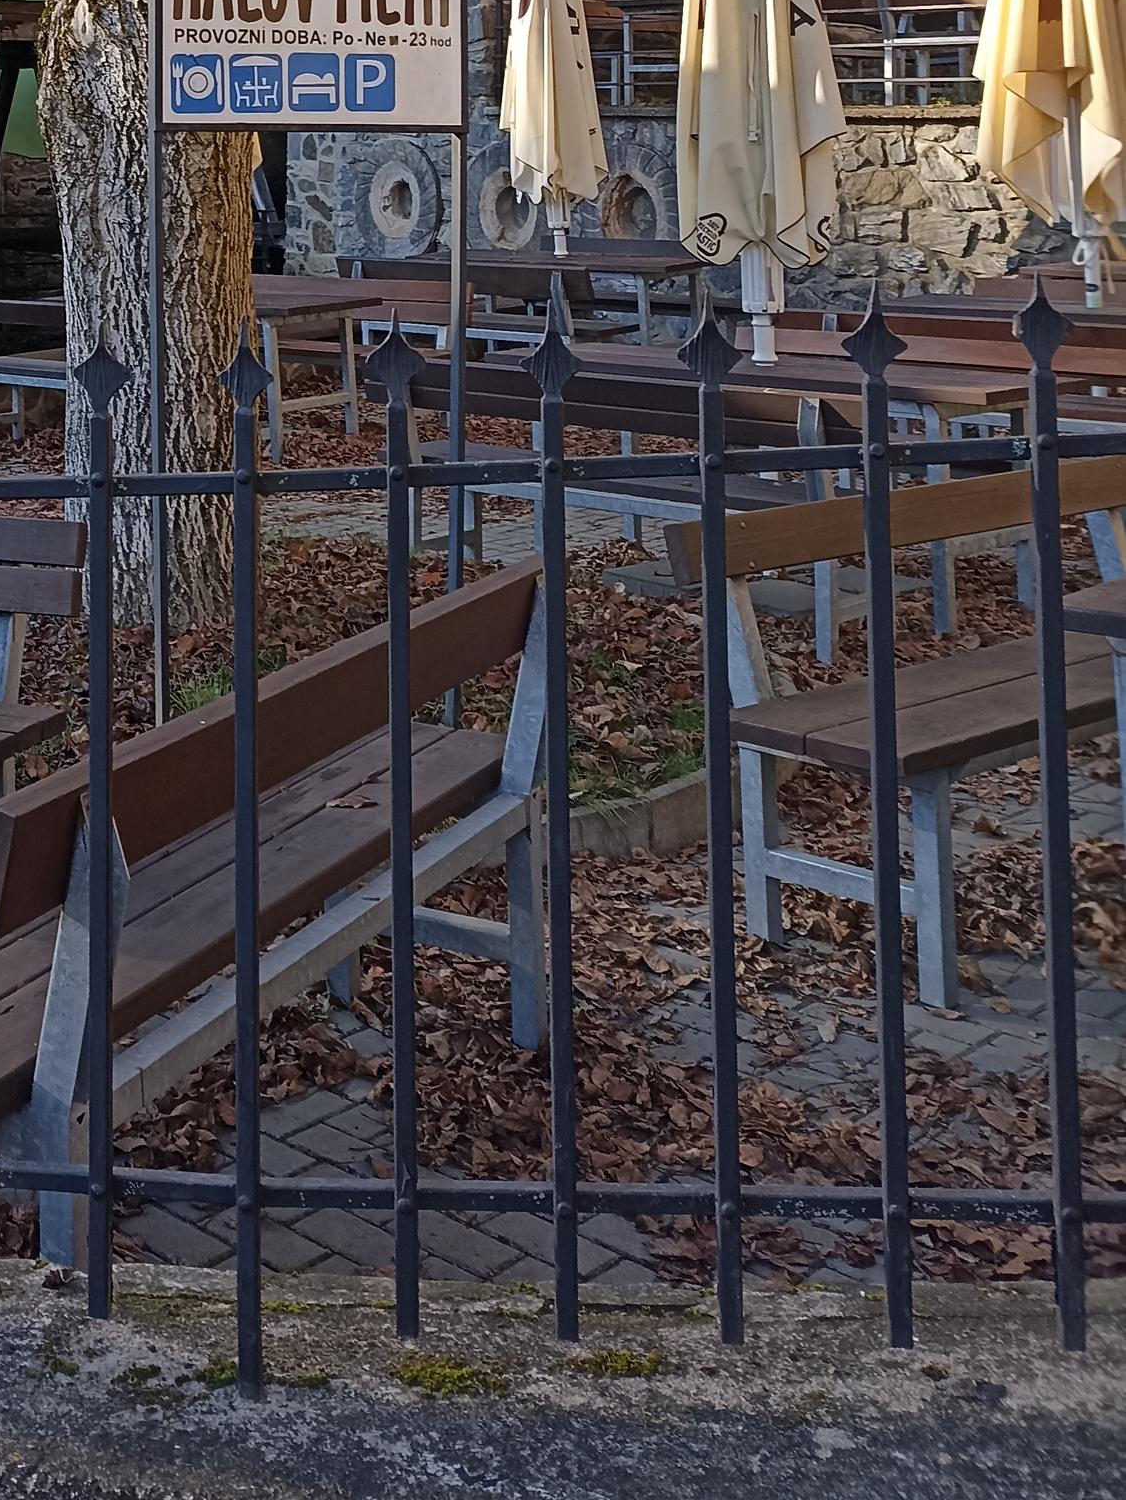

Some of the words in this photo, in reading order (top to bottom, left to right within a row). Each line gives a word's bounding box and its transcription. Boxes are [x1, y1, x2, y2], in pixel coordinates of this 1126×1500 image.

[174, 26, 266, 45] PROVOZNÍ
[271, 29, 327, 45] DOBA:
[355, 59, 386, 105] P
